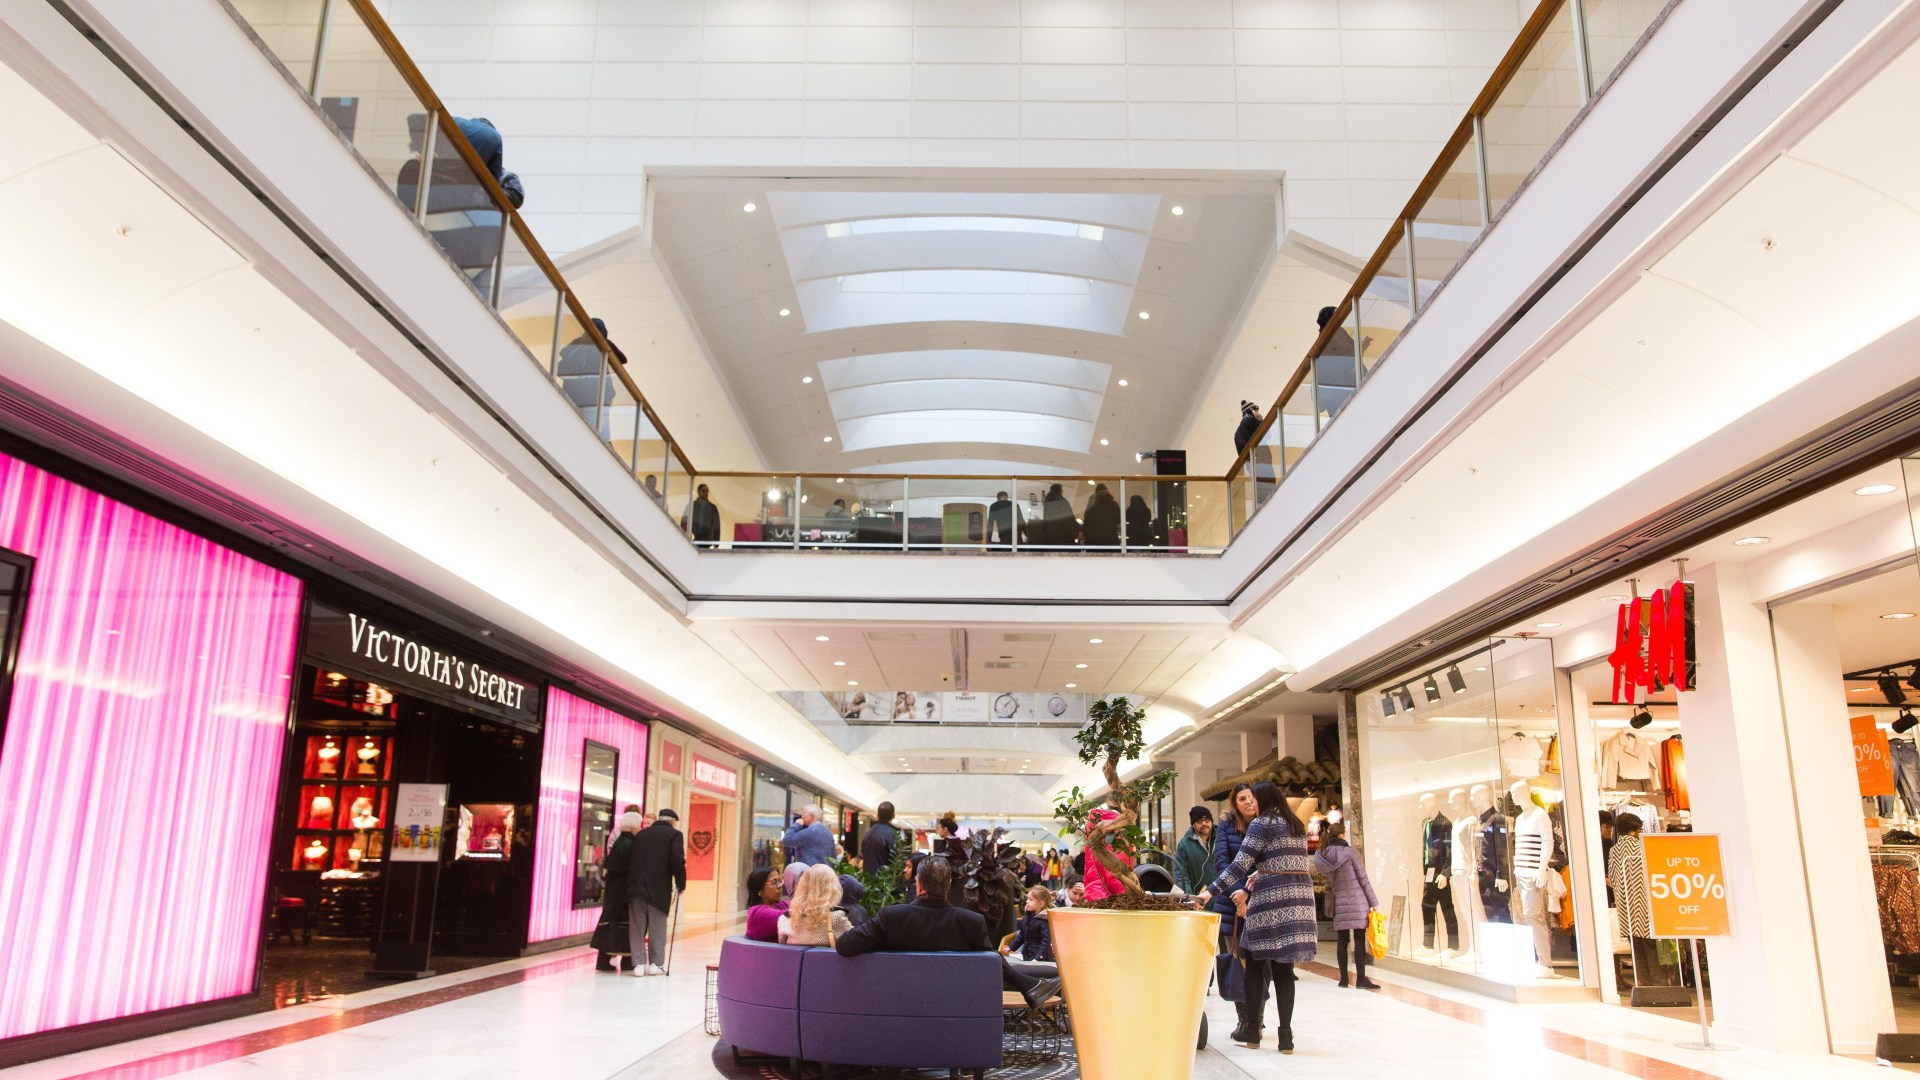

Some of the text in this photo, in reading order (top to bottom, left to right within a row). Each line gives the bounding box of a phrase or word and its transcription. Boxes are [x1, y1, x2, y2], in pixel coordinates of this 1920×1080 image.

[1608, 580, 1686, 704] H&M
[349, 613, 525, 710] VICTORIA'S SECRET
[1858, 732, 1866, 740] TO
[1854, 743, 1881, 762] 0%
[1859, 765, 1869, 773] OFF
[1666, 857, 1701, 867] UP TO
[1651, 873, 1725, 899] 50%
[1678, 905, 1700, 915] OFF
